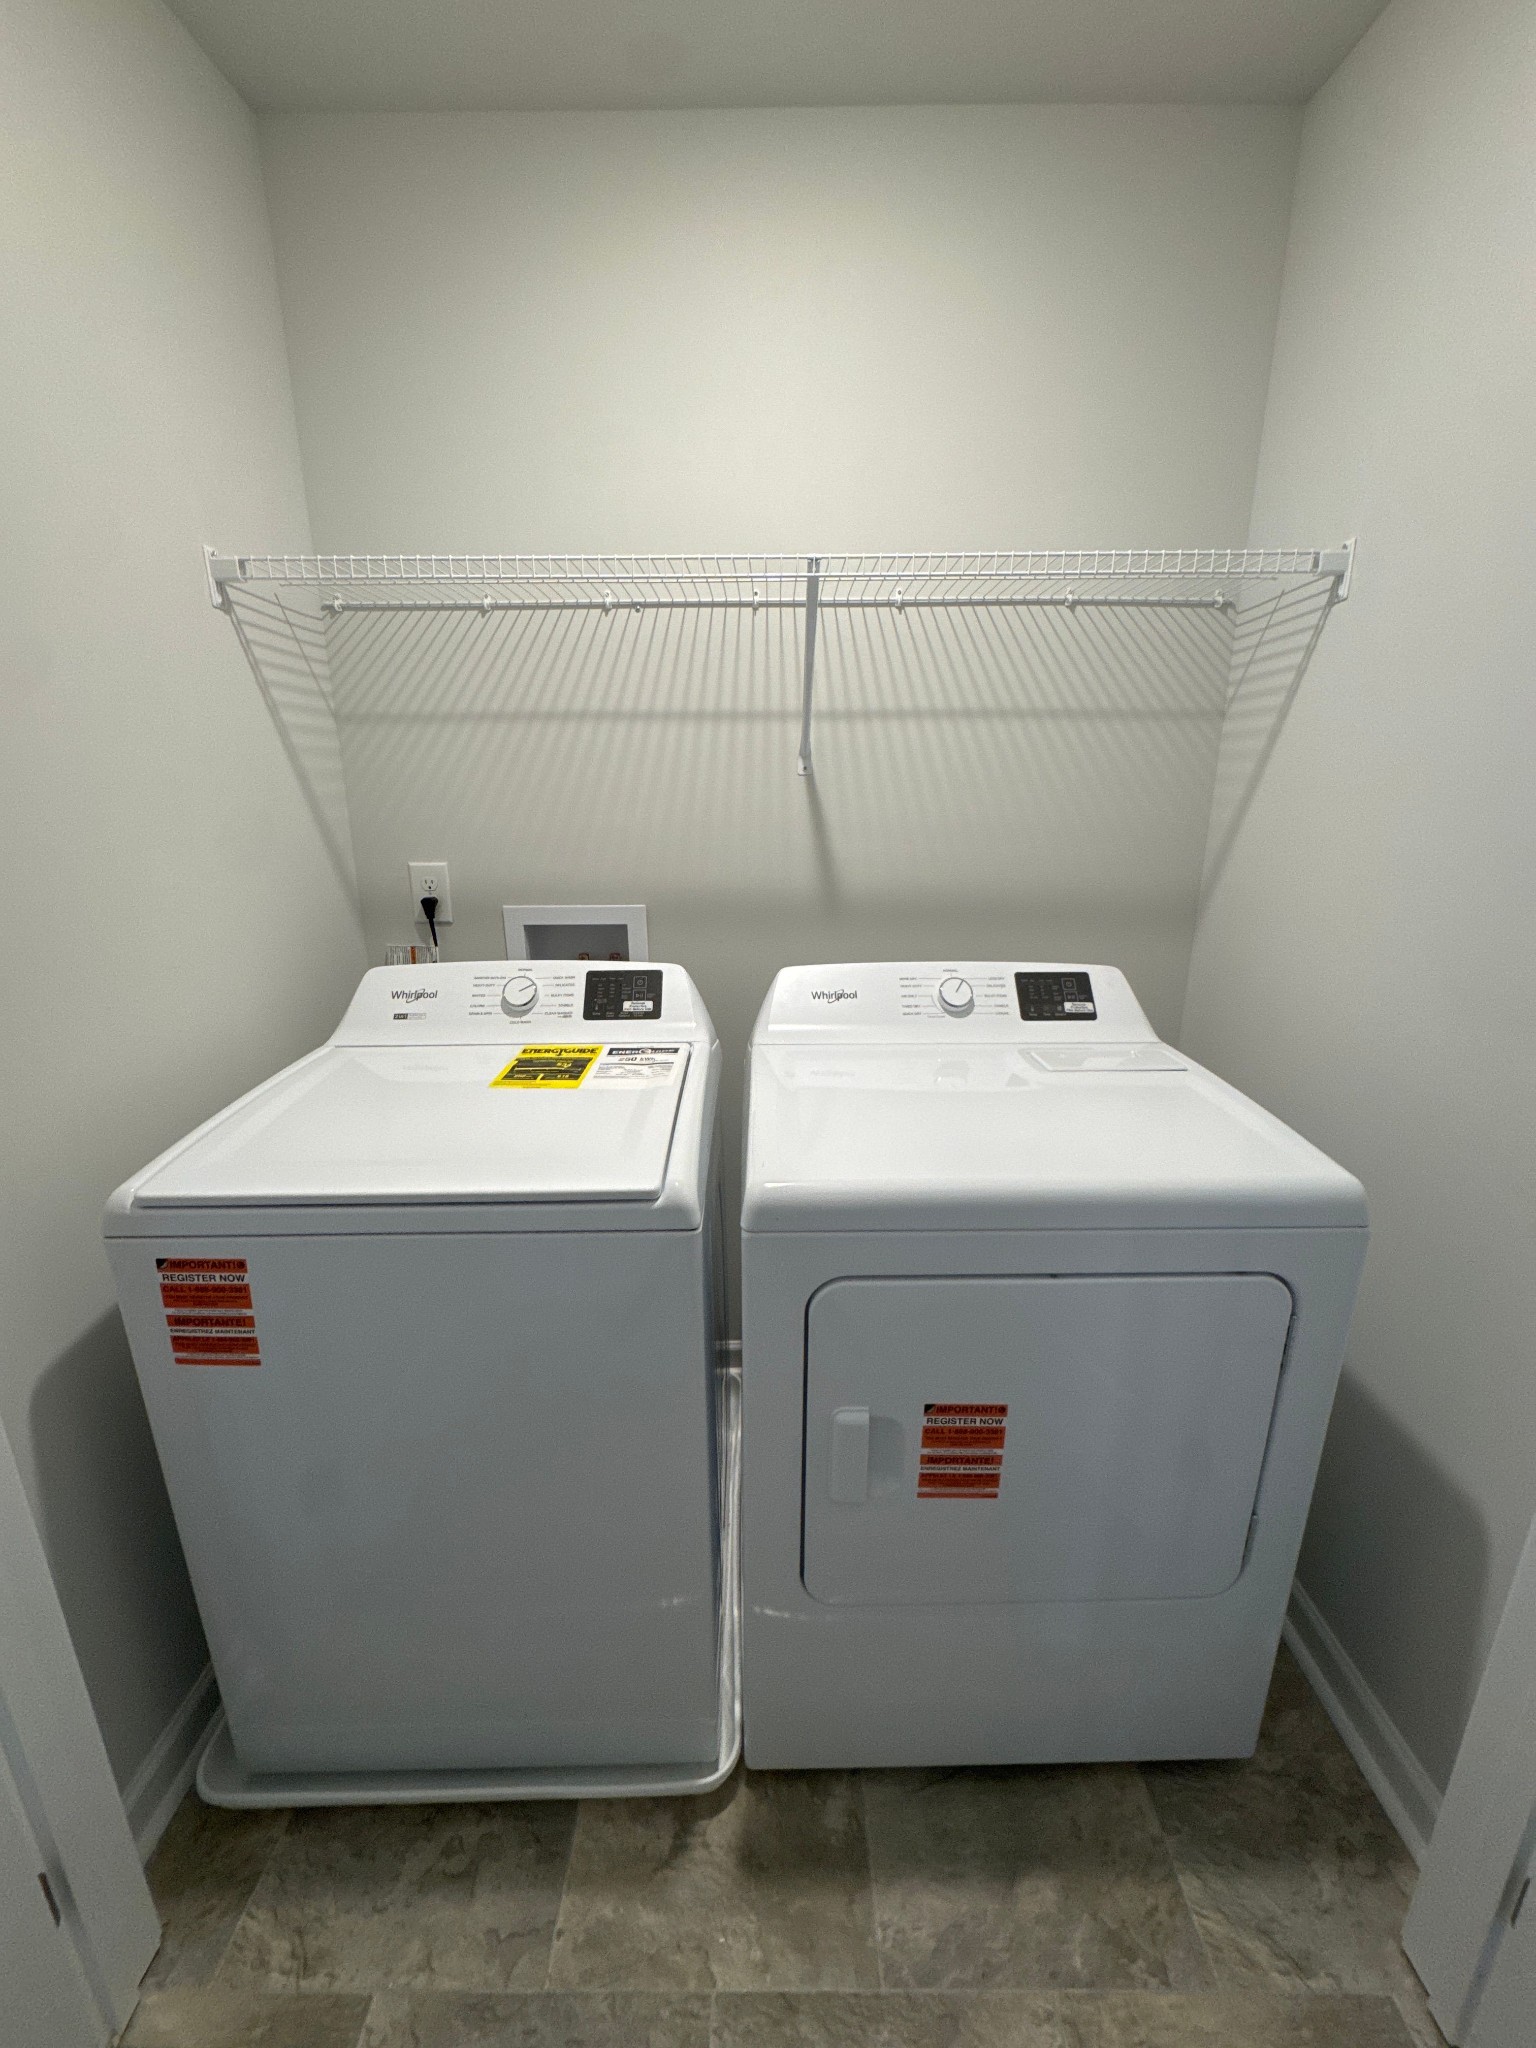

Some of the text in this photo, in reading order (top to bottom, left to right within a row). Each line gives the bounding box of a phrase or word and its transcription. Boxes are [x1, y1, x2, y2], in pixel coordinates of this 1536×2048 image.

[391, 988, 438, 1004] Whirlpool
[811, 988, 858, 1004] Whirlpool
[169, 1260, 236, 1270] IMPORTANT!
[162, 1273, 246, 1282] REGISTER NOW
[935, 1406, 998, 1414] IMPORTANT!
[926, 1417, 1004, 1425] REGISTER NOW
[924, 1427, 946, 1435] CALL
